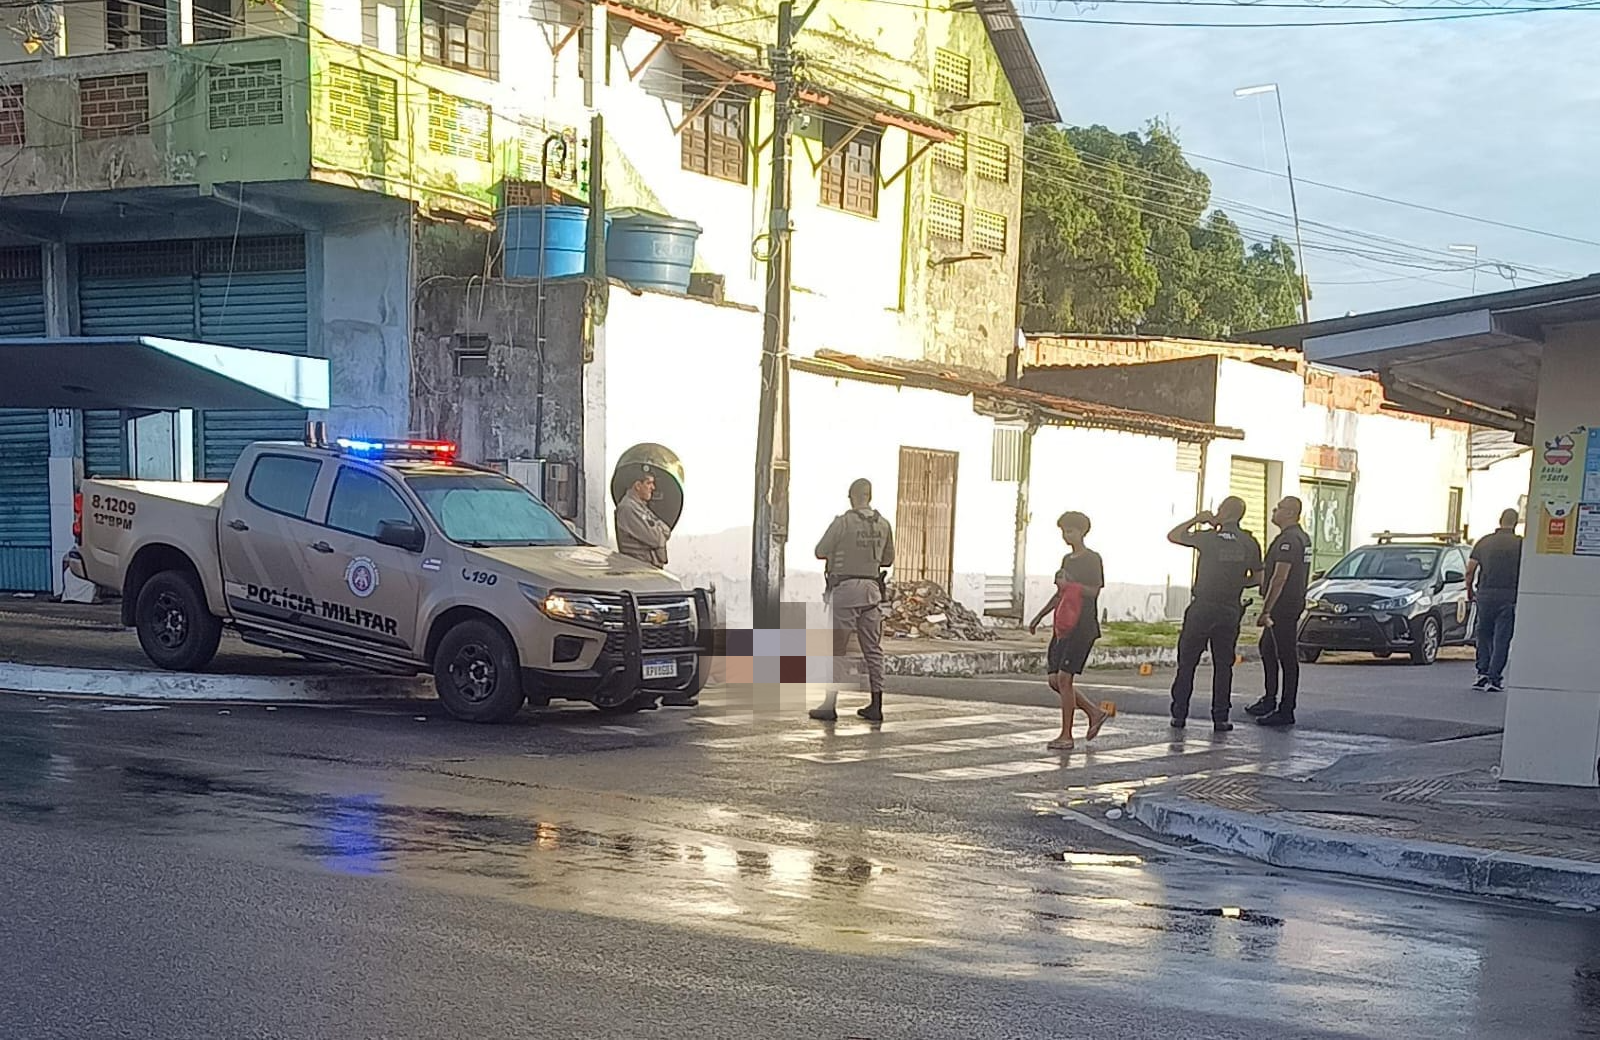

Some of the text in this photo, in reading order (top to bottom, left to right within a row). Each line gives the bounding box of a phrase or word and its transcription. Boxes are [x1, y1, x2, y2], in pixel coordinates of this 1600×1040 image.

[92, 494, 136, 515] 8.1209
[472, 571, 498, 586] 190
[247, 583, 398, 636] POLÍCIA MILITAR
